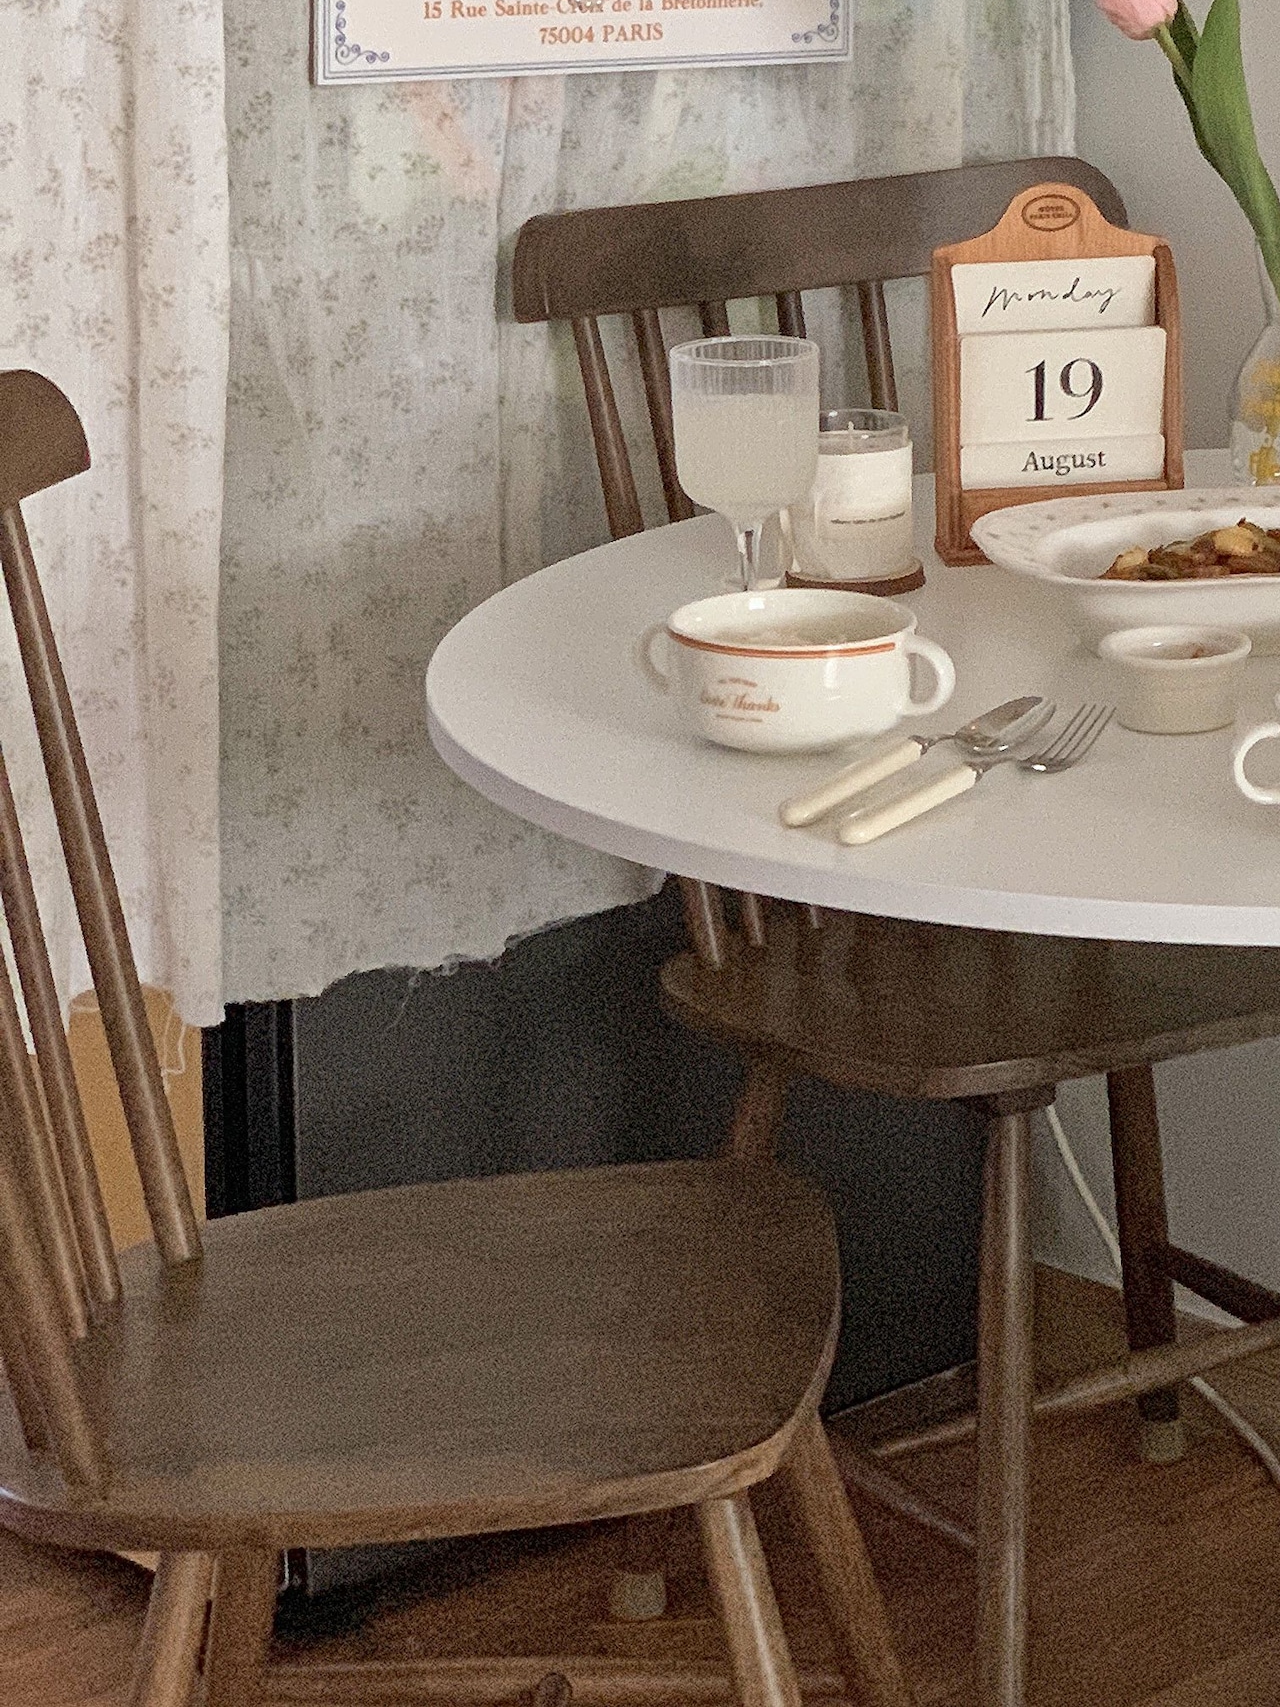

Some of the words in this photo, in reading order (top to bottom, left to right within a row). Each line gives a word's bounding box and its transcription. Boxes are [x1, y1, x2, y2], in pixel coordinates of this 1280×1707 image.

[424, 0, 443, 20] 15
[450, 0, 488, 19] Rue
[539, 26, 595, 45] 75004
[602, 22, 664, 42] PARIS
[981, 277, 1122, 318] Monday
[1025, 357, 1103, 422] 19
[1021, 451, 1107, 476] August
